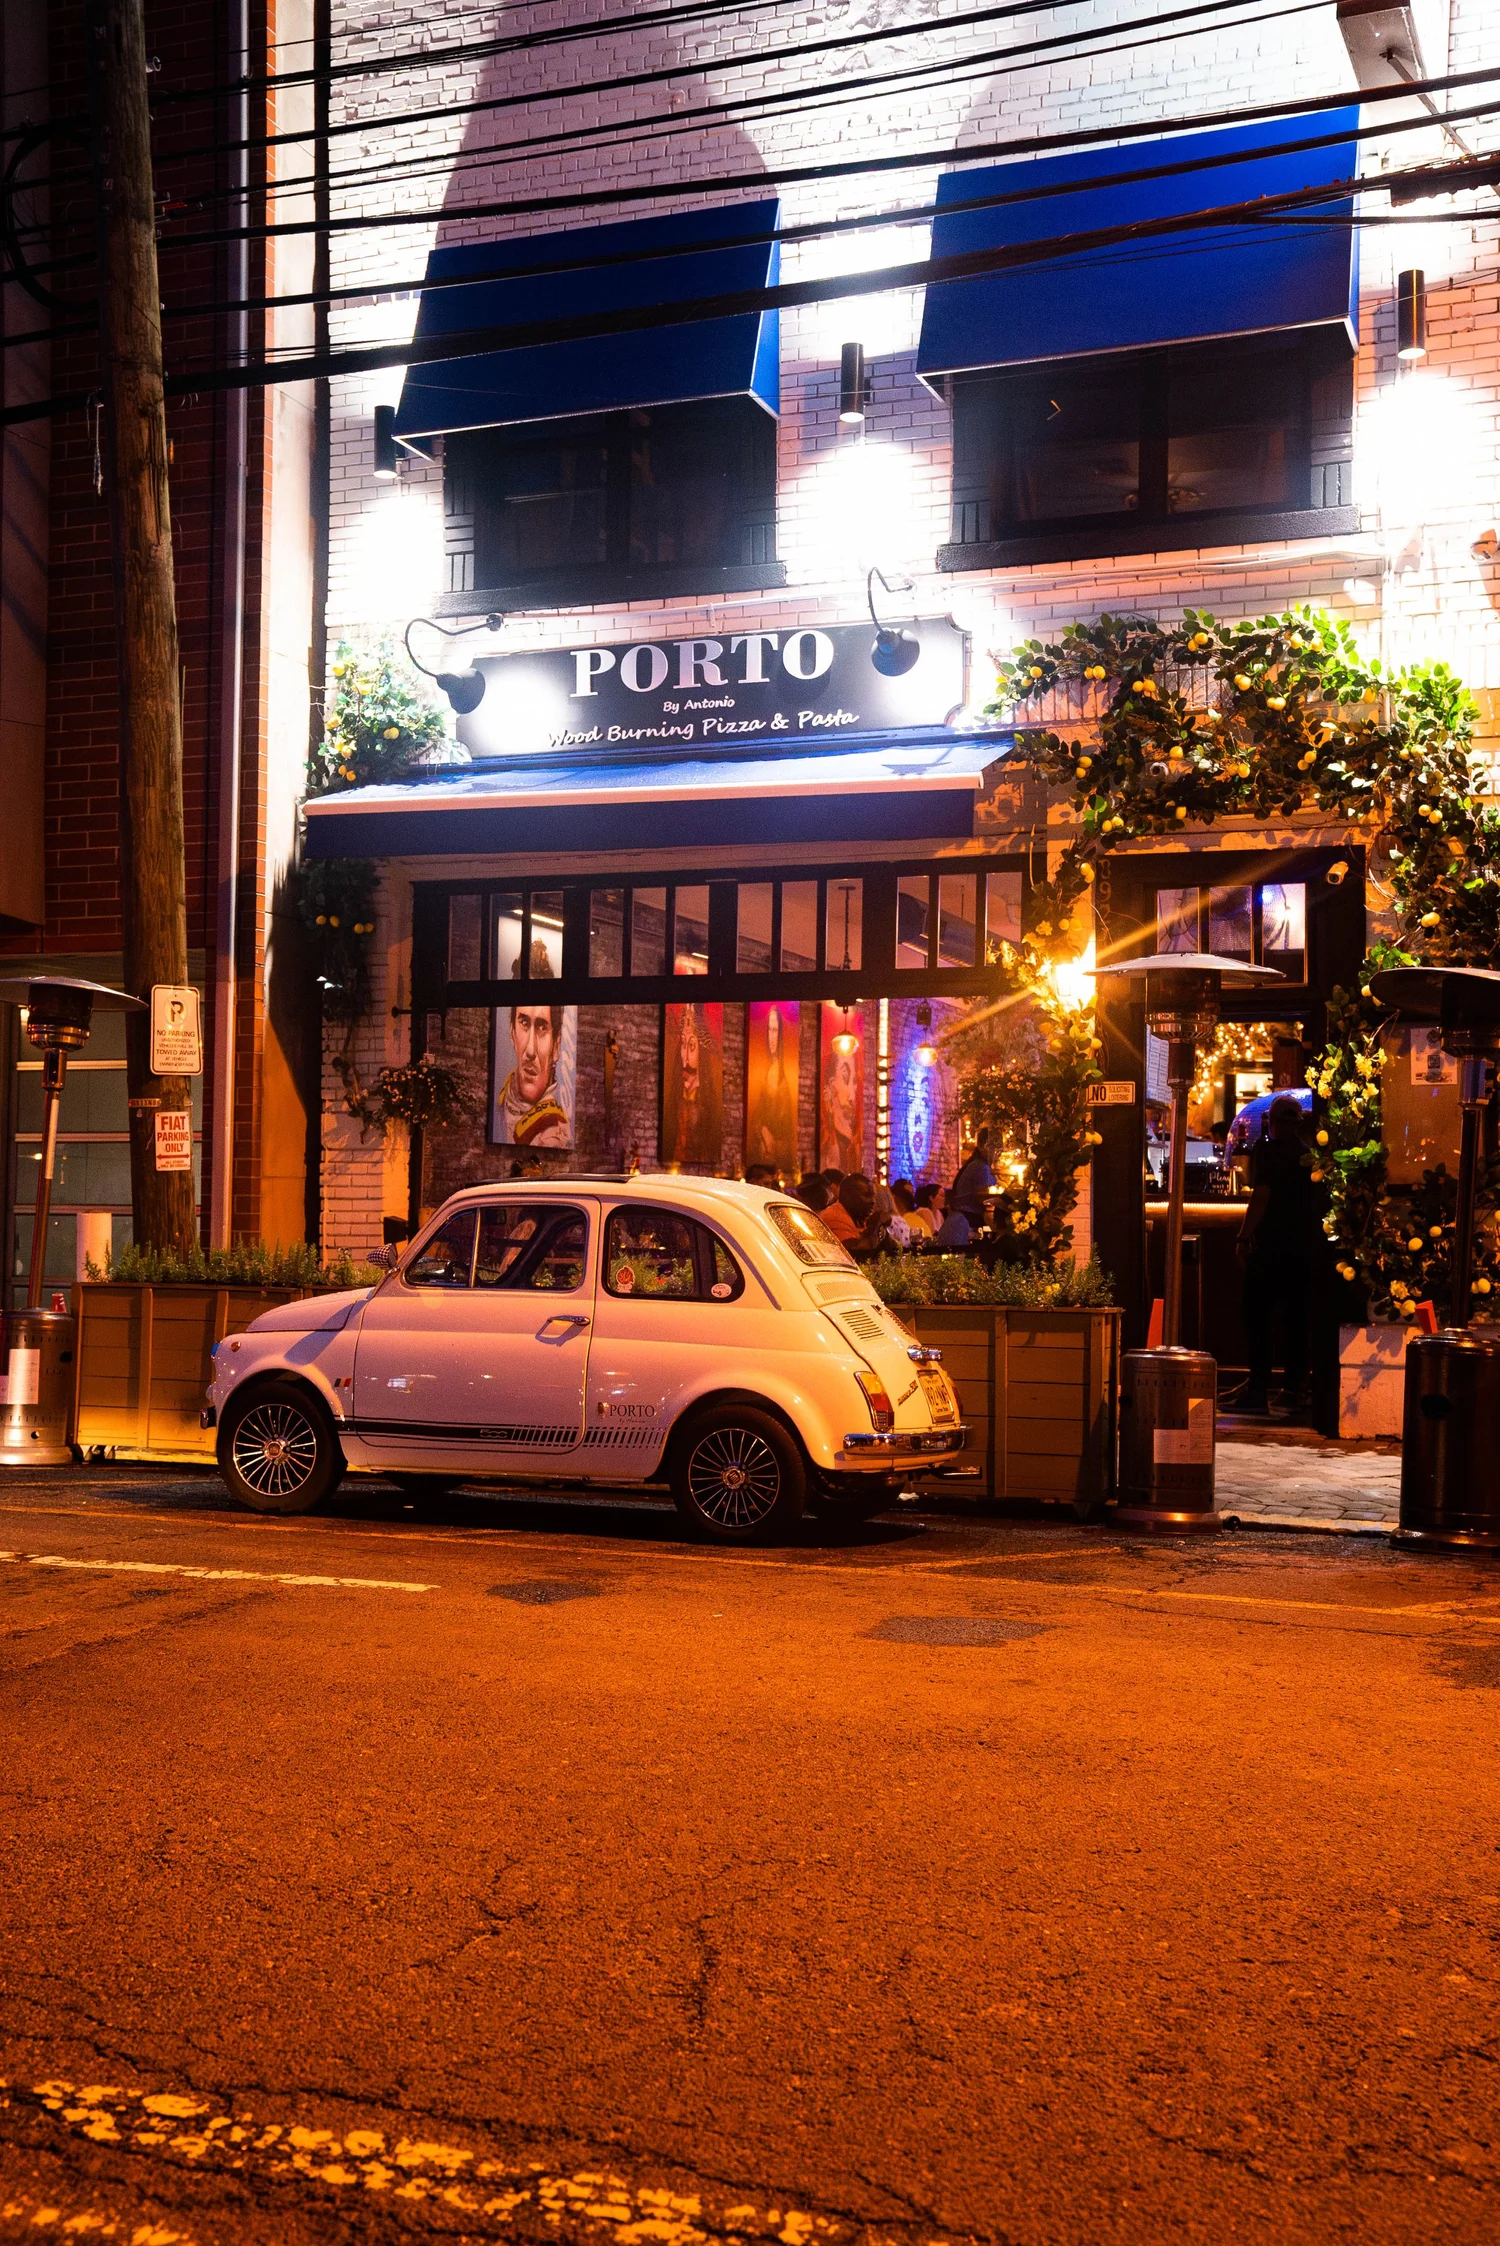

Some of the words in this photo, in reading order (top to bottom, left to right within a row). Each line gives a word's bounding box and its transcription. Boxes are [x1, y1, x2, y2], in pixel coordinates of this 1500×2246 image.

[570, 629, 834, 698] PORTO
[663, 701, 680, 714] By
[684, 695, 735, 710] Antonio
[549, 725, 603, 747] Wood
[607, 720, 694, 740] Burning
[702, 717, 767, 736] Pizza
[770, 712, 790, 730] &
[797, 708, 860, 729] Pasta
[156, 1029, 167, 1037] NO
[168, 1029, 196, 1038] PARKING
[155, 1048, 178, 1056] TOWED
[1092, 1085, 1107, 1101] NO
[160, 1116, 186, 1131] FIAT
[157, 1131, 189, 1142] PARKING
[165, 1142, 184, 1153] ONLY
[609, 1404, 655, 1418] PORTO
